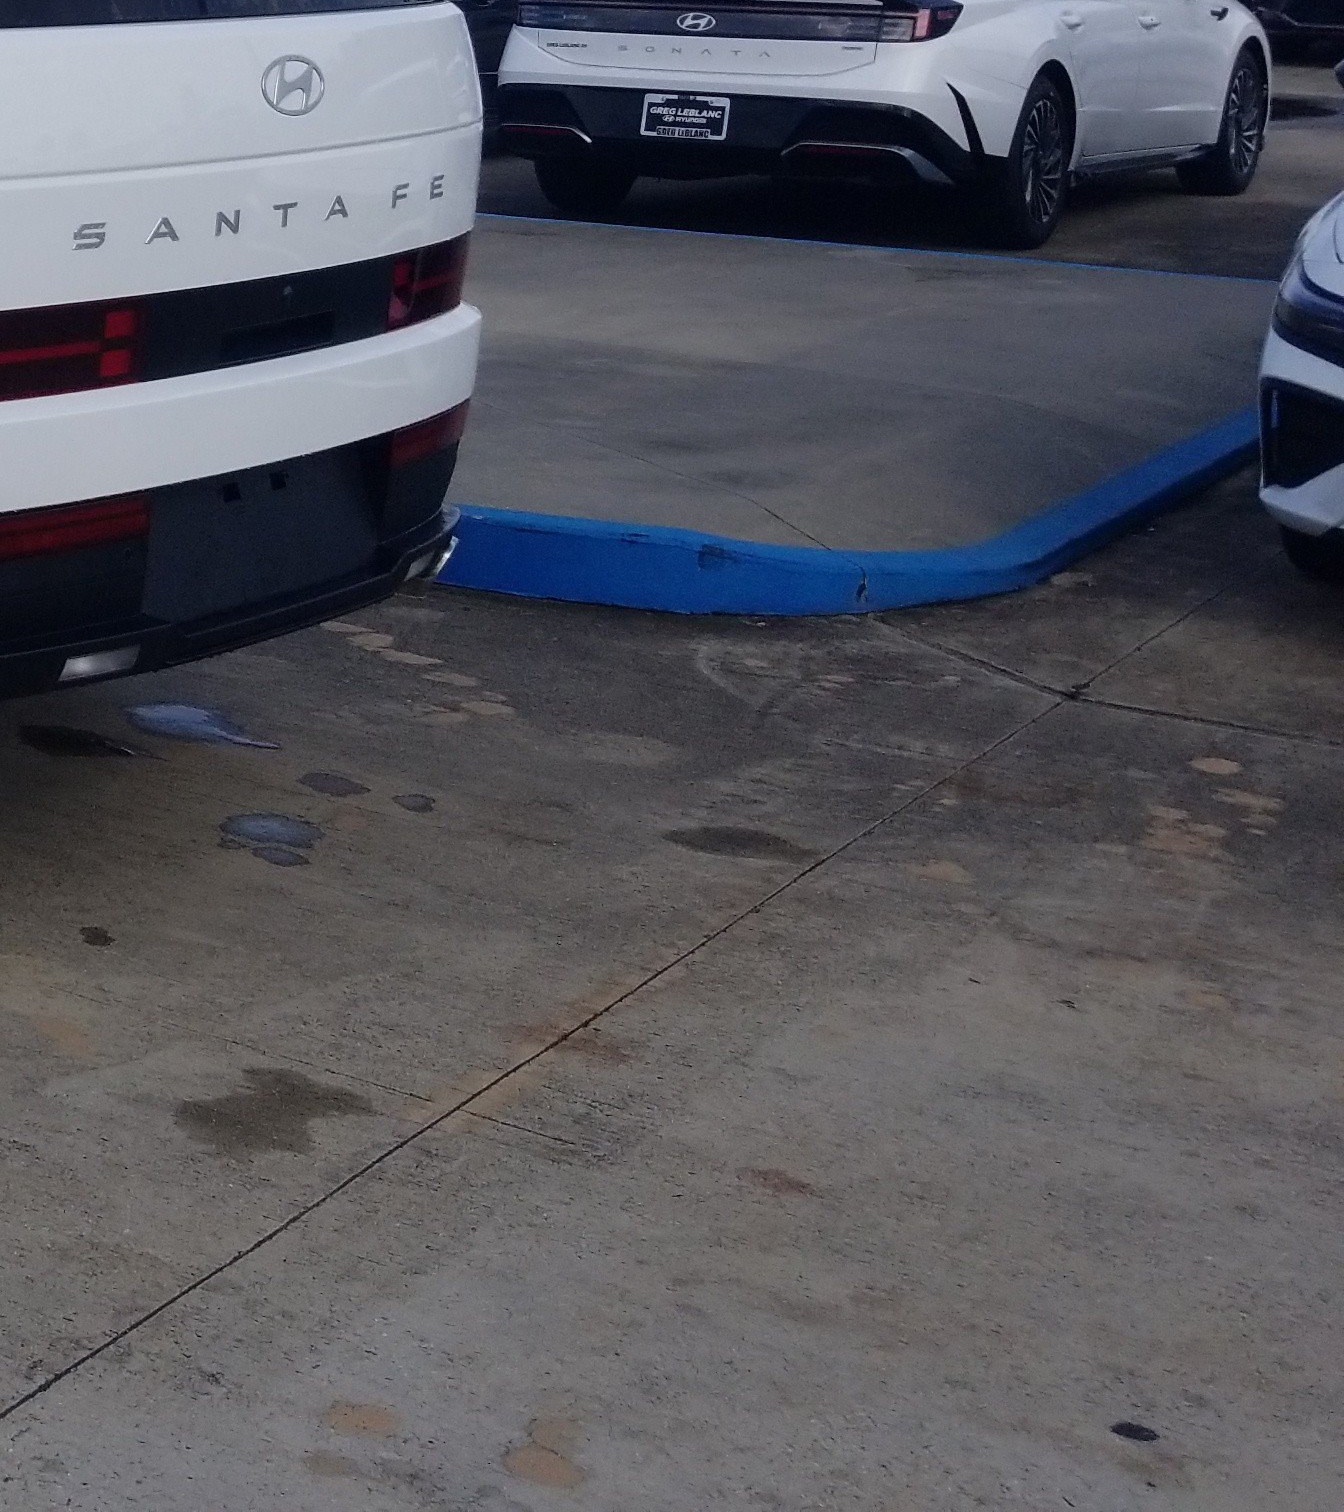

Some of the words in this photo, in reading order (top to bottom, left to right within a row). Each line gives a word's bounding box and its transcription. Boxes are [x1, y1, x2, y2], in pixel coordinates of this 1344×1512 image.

[617, 44, 771, 58] SONATA
[650, 106, 677, 116] GREG
[677, 108, 723, 119] LEBLANC
[72, 195, 349, 251] SANTA
[392, 175, 445, 209] FE
